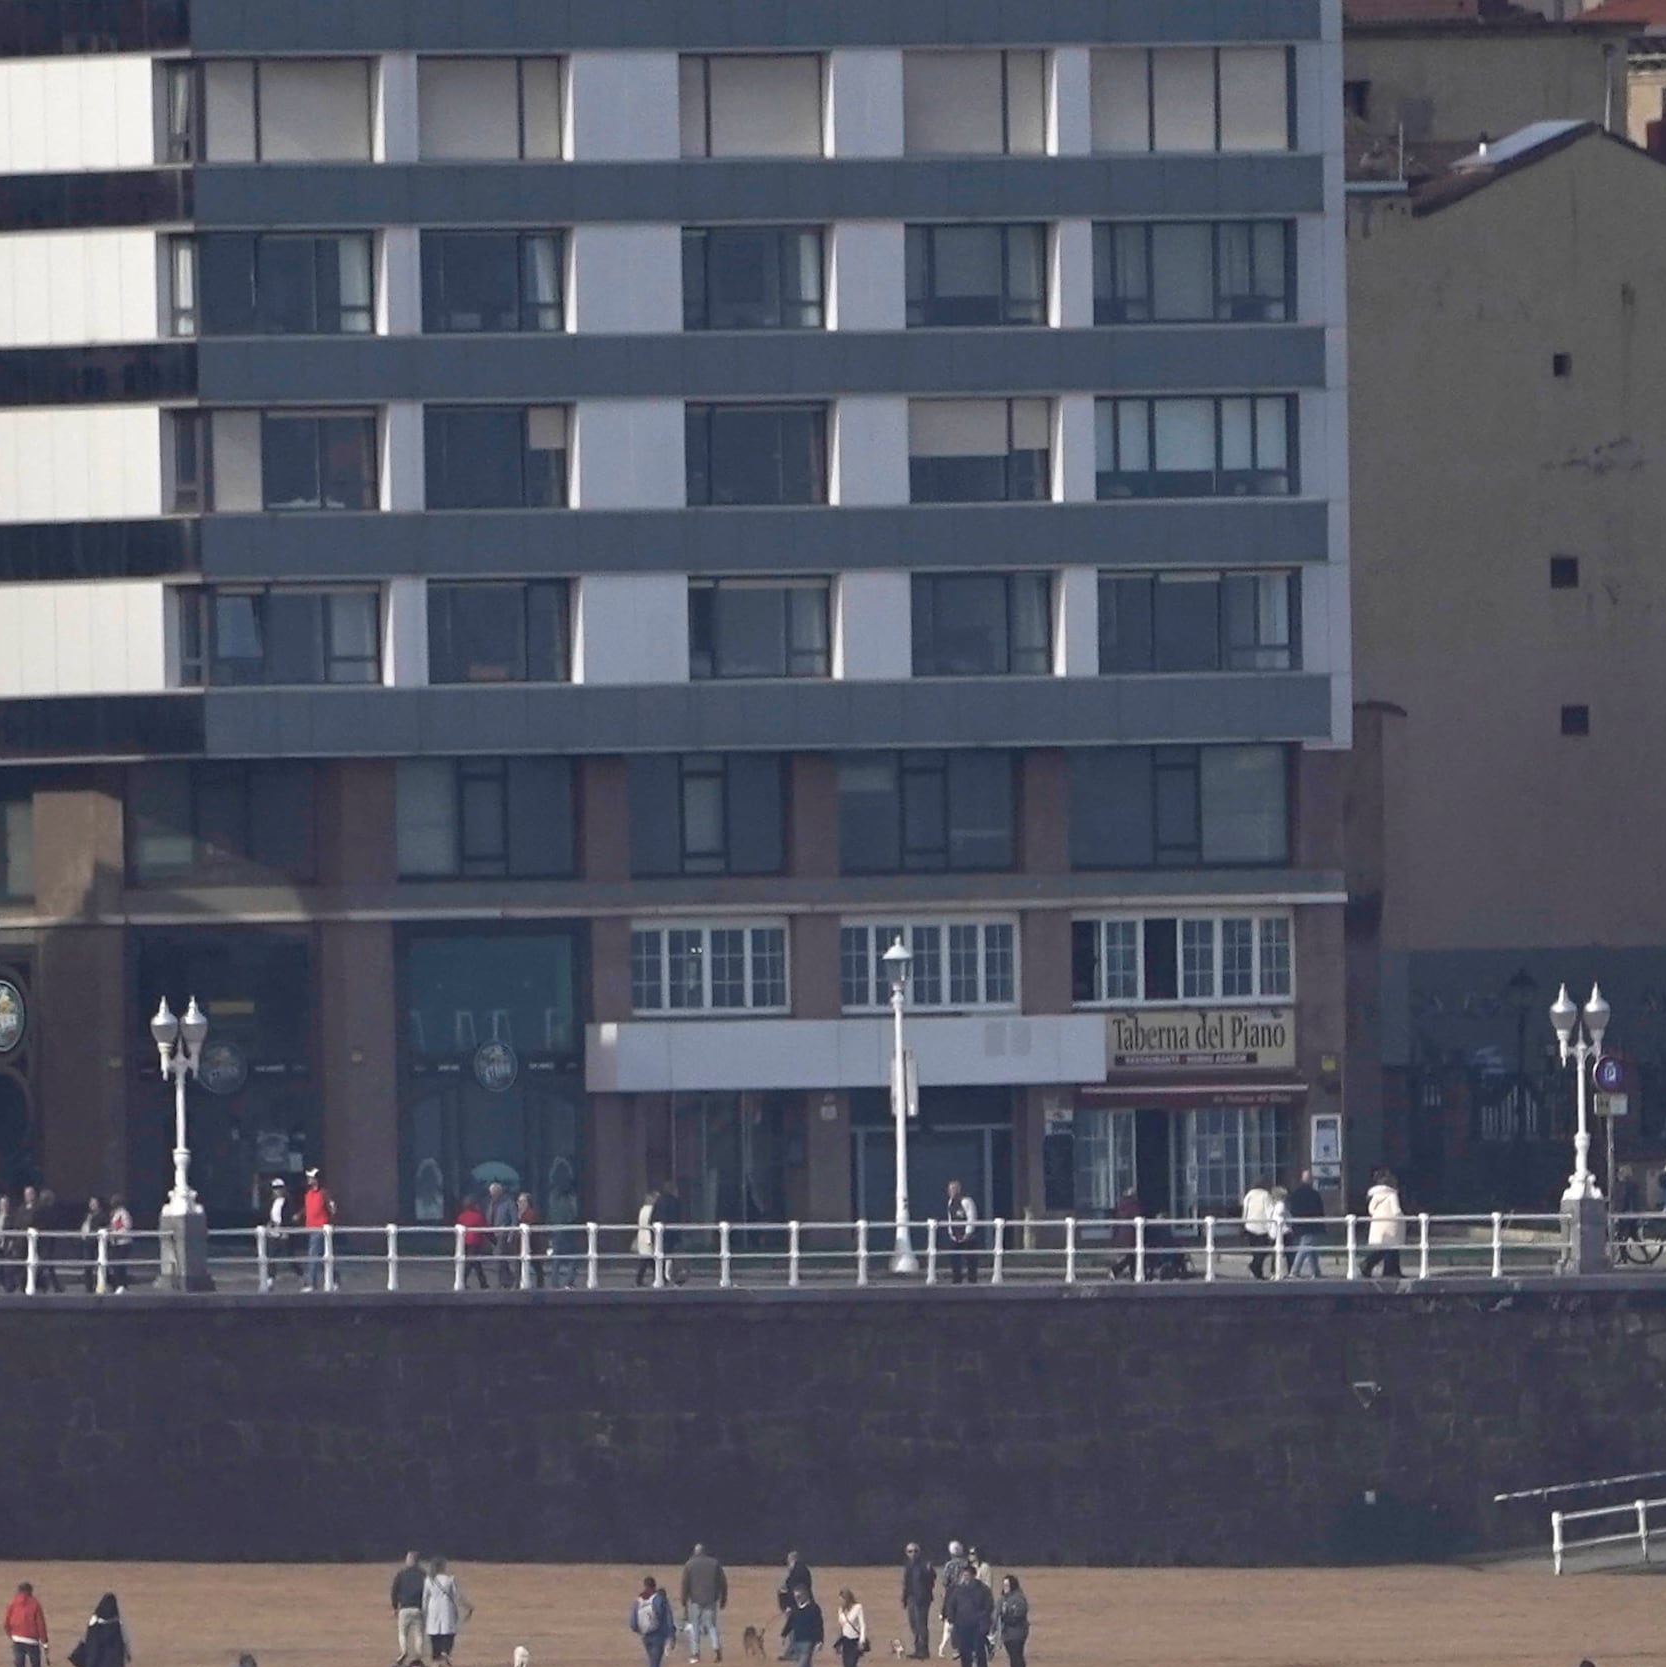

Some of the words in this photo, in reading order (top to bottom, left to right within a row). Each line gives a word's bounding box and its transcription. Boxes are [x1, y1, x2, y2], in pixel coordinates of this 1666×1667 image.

[1112, 1012, 1189, 1051] Taberna
[1195, 1010, 1224, 1050] del
[1231, 1013, 1286, 1050] Piano
